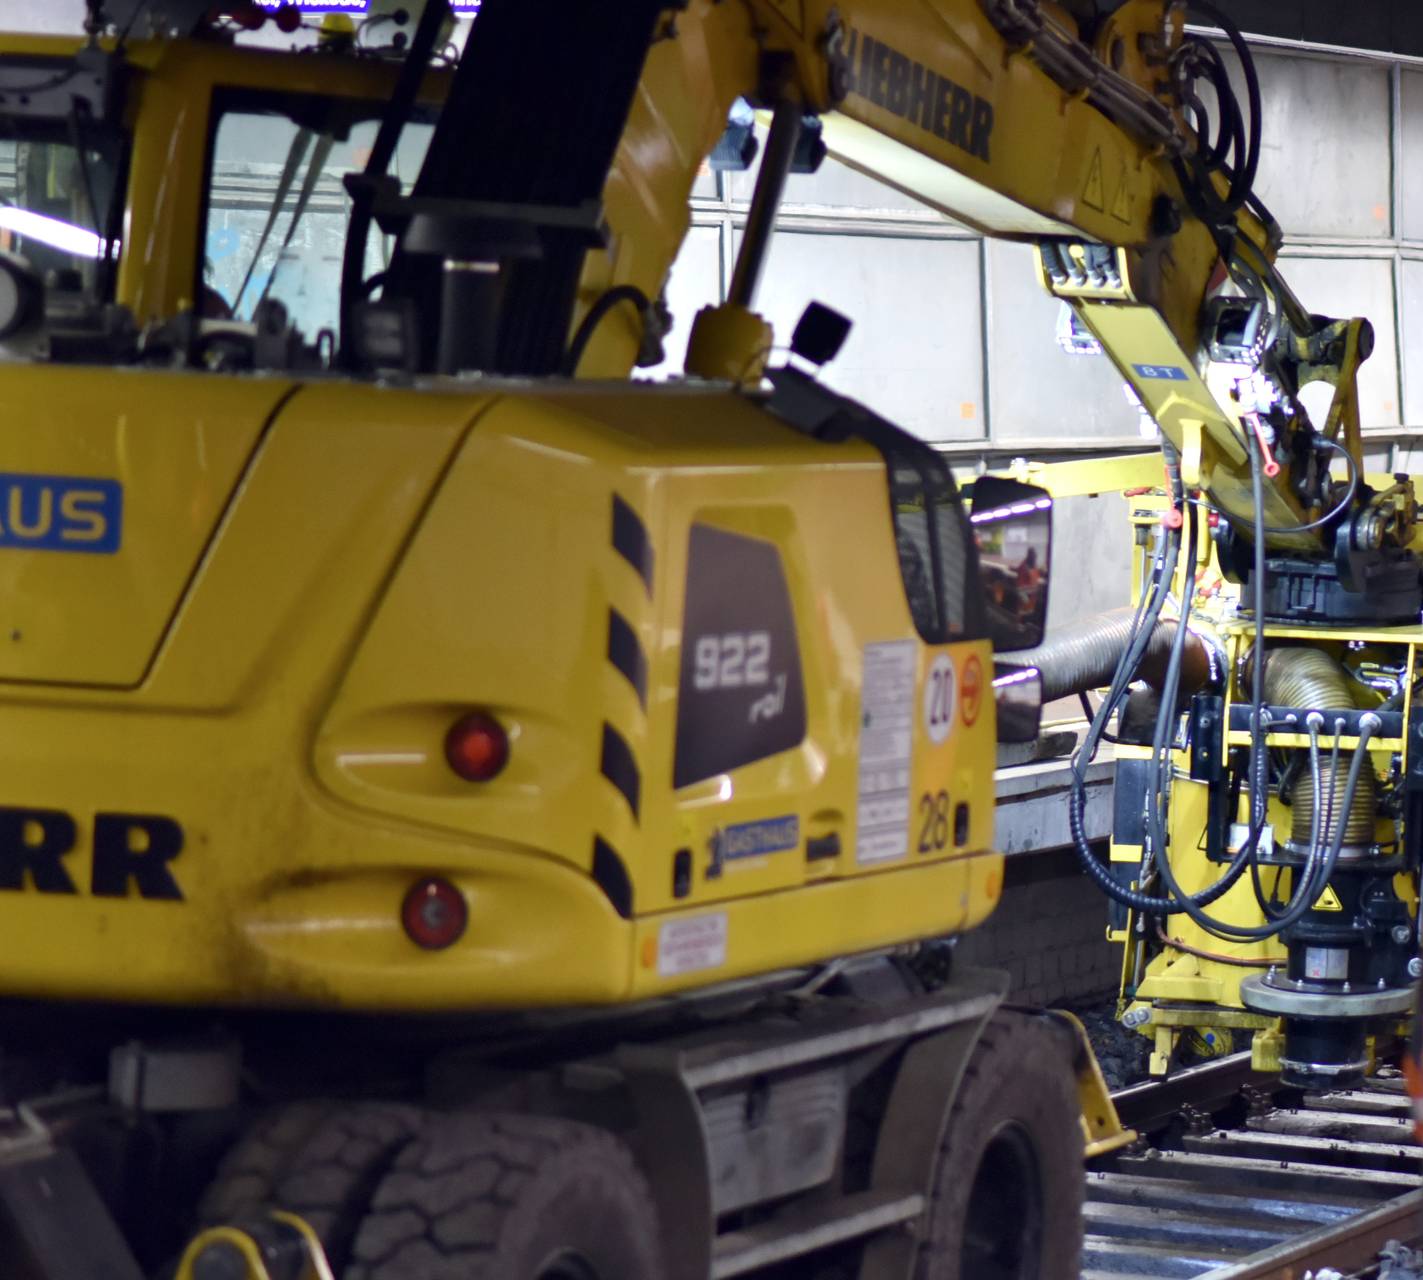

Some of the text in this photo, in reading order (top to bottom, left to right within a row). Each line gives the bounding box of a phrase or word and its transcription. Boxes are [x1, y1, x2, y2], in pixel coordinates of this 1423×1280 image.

[849, 27, 993, 164] LIEBHERR
[0, 486, 107, 541] US
[694, 630, 769, 691] 922
[929, 667, 953, 725] 20
[916, 788, 950, 854] 28
